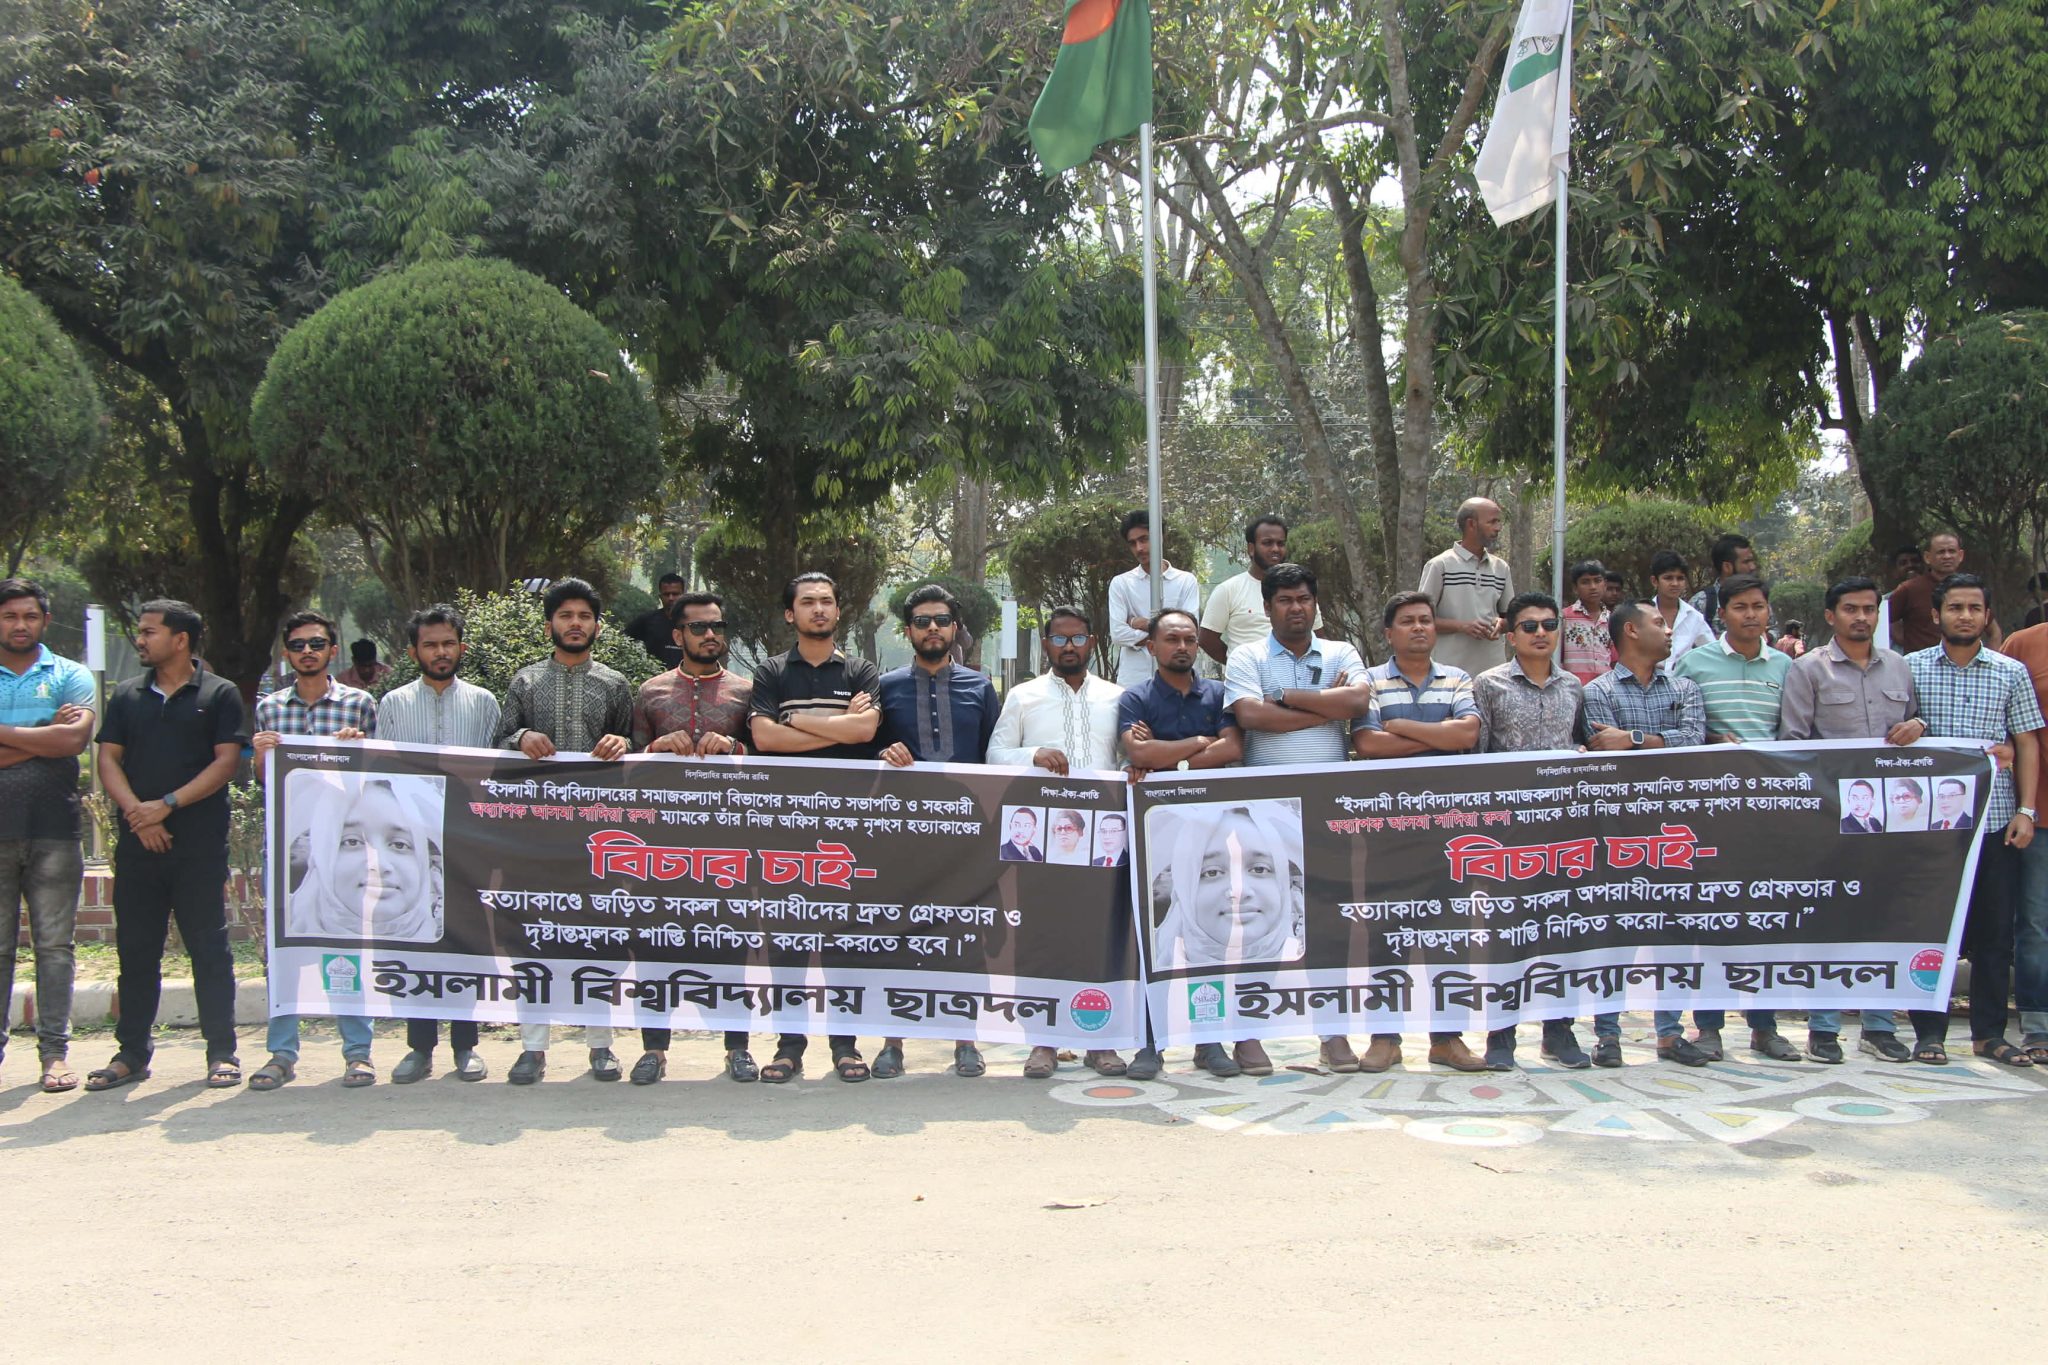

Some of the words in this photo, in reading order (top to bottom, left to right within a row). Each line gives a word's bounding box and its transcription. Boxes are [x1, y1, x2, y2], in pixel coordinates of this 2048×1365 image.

[543, 781, 637, 802] বিশ্ববিদ্যালয়ের
[642, 788, 723, 806] সমাজকল্যাণ
[726, 788, 782, 807] বিভাগের
[787, 791, 842, 810] সম্মানিত
[847, 793, 902, 812] সভাপতি
[906, 800, 917, 812] ও
[922, 796, 975, 816] সহকারী
[1397, 790, 1492, 811] বিশ্ববিদ্যালয়ের
[1495, 784, 1573, 805] সমাজকল্যাণ
[1577, 779, 1630, 799] বিভাগের
[1634, 775, 1685, 795] সম্মানিত
[1688, 772, 1741, 792] সভাপতি
[1745, 778, 1756, 790] ও
[1761, 772, 1813, 792] সহকারী
[469, 801, 526, 819] অধ্যাপক
[531, 805, 574, 821] আসমা
[578, 802, 624, 823] সাদিয়া
[627, 808, 657, 825] রুনা
[661, 810, 710, 825] ম্যামকে
[715, 807, 741, 826] তাঁর
[746, 809, 775, 828] নিজ
[778, 811, 819, 830] অফিস
[824, 816, 859, 832] কক্ষে
[862, 817, 902, 838] নৃশংস
[907, 819, 981, 835] হত্যাকাণ্ডের
[1326, 816, 1383, 835] অধ্যাপক
[1388, 813, 1431, 832] আসমা
[1434, 809, 1479, 829] সাদিয়া
[1482, 809, 1512, 827] রুনা
[1515, 807, 1564, 824] ম্যামকে
[1566, 800, 1590, 818] তাঁর
[1594, 797, 1621, 816] নিজ
[1625, 797, 1664, 815] অফিস
[1668, 798, 1701, 813] কক্ষে
[1704, 798, 1741, 817] নৃশংস
[1745, 796, 1822, 812] হত্যাকাণ্ডের
[586, 829, 752, 889] বিচার
[1444, 834, 1598, 883] বিচার
[477, 889, 583, 911] হত্যাকাণ্ডে
[590, 888, 657, 919] জড়িত
[664, 895, 720, 918] সকল
[726, 893, 851, 922] অপরাধীদের
[856, 903, 904, 925] দ্রুত
[909, 902, 998, 926] গ্রেফতার
[1003, 909, 1021, 927] ও
[1338, 899, 1442, 922] হত্যাকাণ্ডে
[1449, 891, 1516, 920] জড়িত
[1522, 889, 1571, 912] সকল
[1575, 877, 1693, 904] অপরাধীদের
[1697, 880, 1742, 902] দ্রুত
[1749, 878, 1836, 900] গ্রেফতার
[1842, 879, 1860, 896] ও
[523, 918, 631, 952] দৃষ্টান্তমূলক
[637, 922, 687, 949] শাস্তি
[691, 923, 764, 950] নিশ্চিত
[1384, 926, 1491, 957] দৃষ্টান্তমূলক
[1498, 919, 1540, 947] শাস্তি
[1543, 912, 1610, 940] নিশ্চিত
[372, 960, 553, 1004] ইসলামী
[571, 966, 866, 1016] বিশ্ববিদ্যালয়
[884, 987, 1060, 1027] ছাত্রদল
[1235, 968, 1414, 1019] ইসলামী
[1431, 961, 1704, 1012] বিশ্ববিদ্যালয়
[1722, 961, 1898, 994] ছাত্রদল
